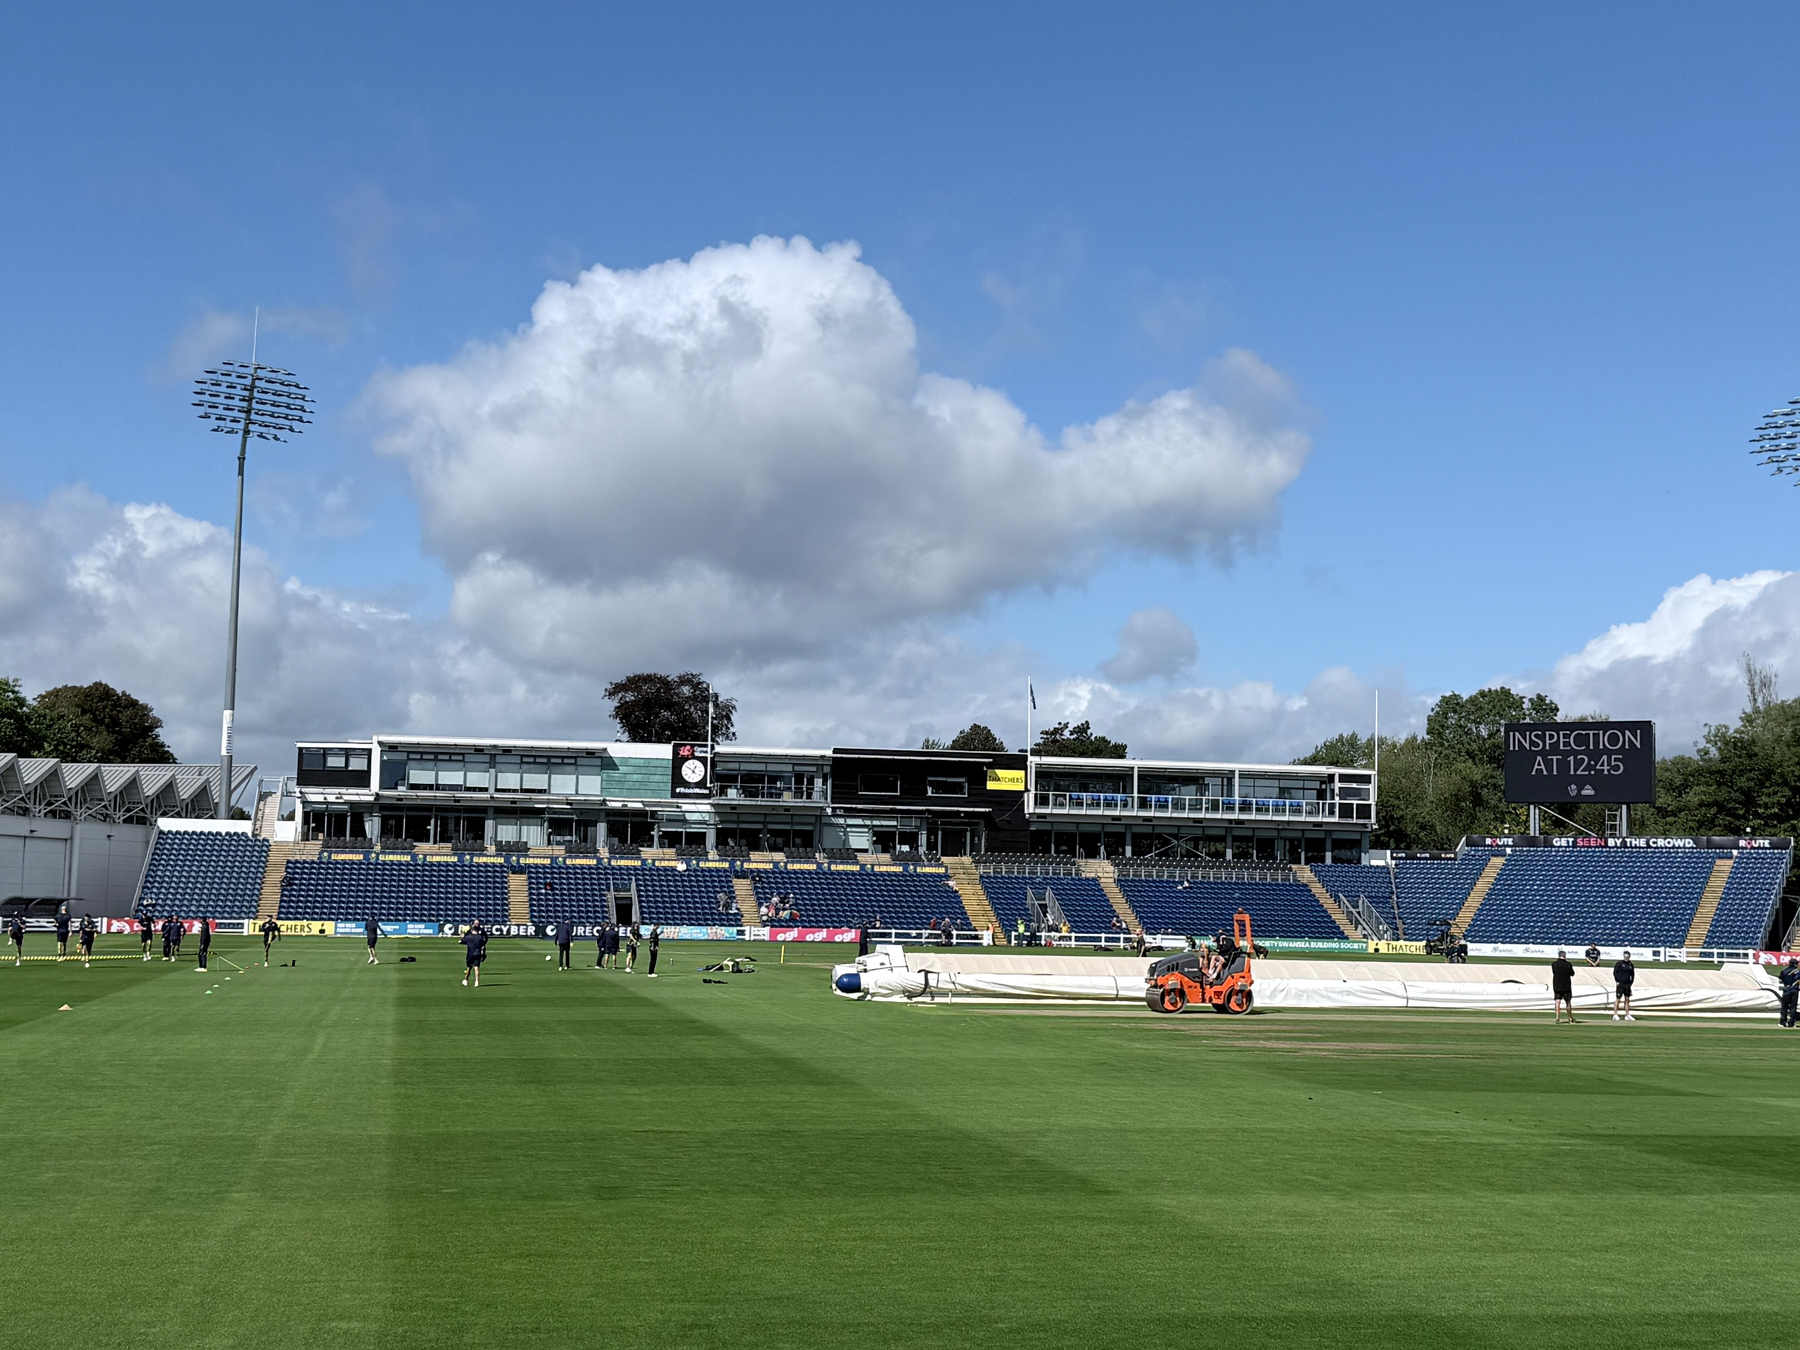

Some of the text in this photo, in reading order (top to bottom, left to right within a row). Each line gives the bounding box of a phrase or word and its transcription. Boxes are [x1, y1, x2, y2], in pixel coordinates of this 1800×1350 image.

[1509, 730, 1641, 751] INSPECTION
[1531, 755, 1624, 775] AT 12:45
[988, 775, 1024, 784] THATCHERS
[1485, 838, 1514, 847] ROUTE
[1552, 837, 1696, 848] GET SEEN BY THE CROWD.
[1739, 839, 1770, 848] ROUTE
[252, 923, 312, 933] TCHERS
[777, 929, 798, 941] ogi
[805, 929, 827, 942] ogi
[834, 929, 856, 942] ogi
[1311, 941, 1339, 949] BUILDING
[1386, 943, 1426, 953] THATCHE
